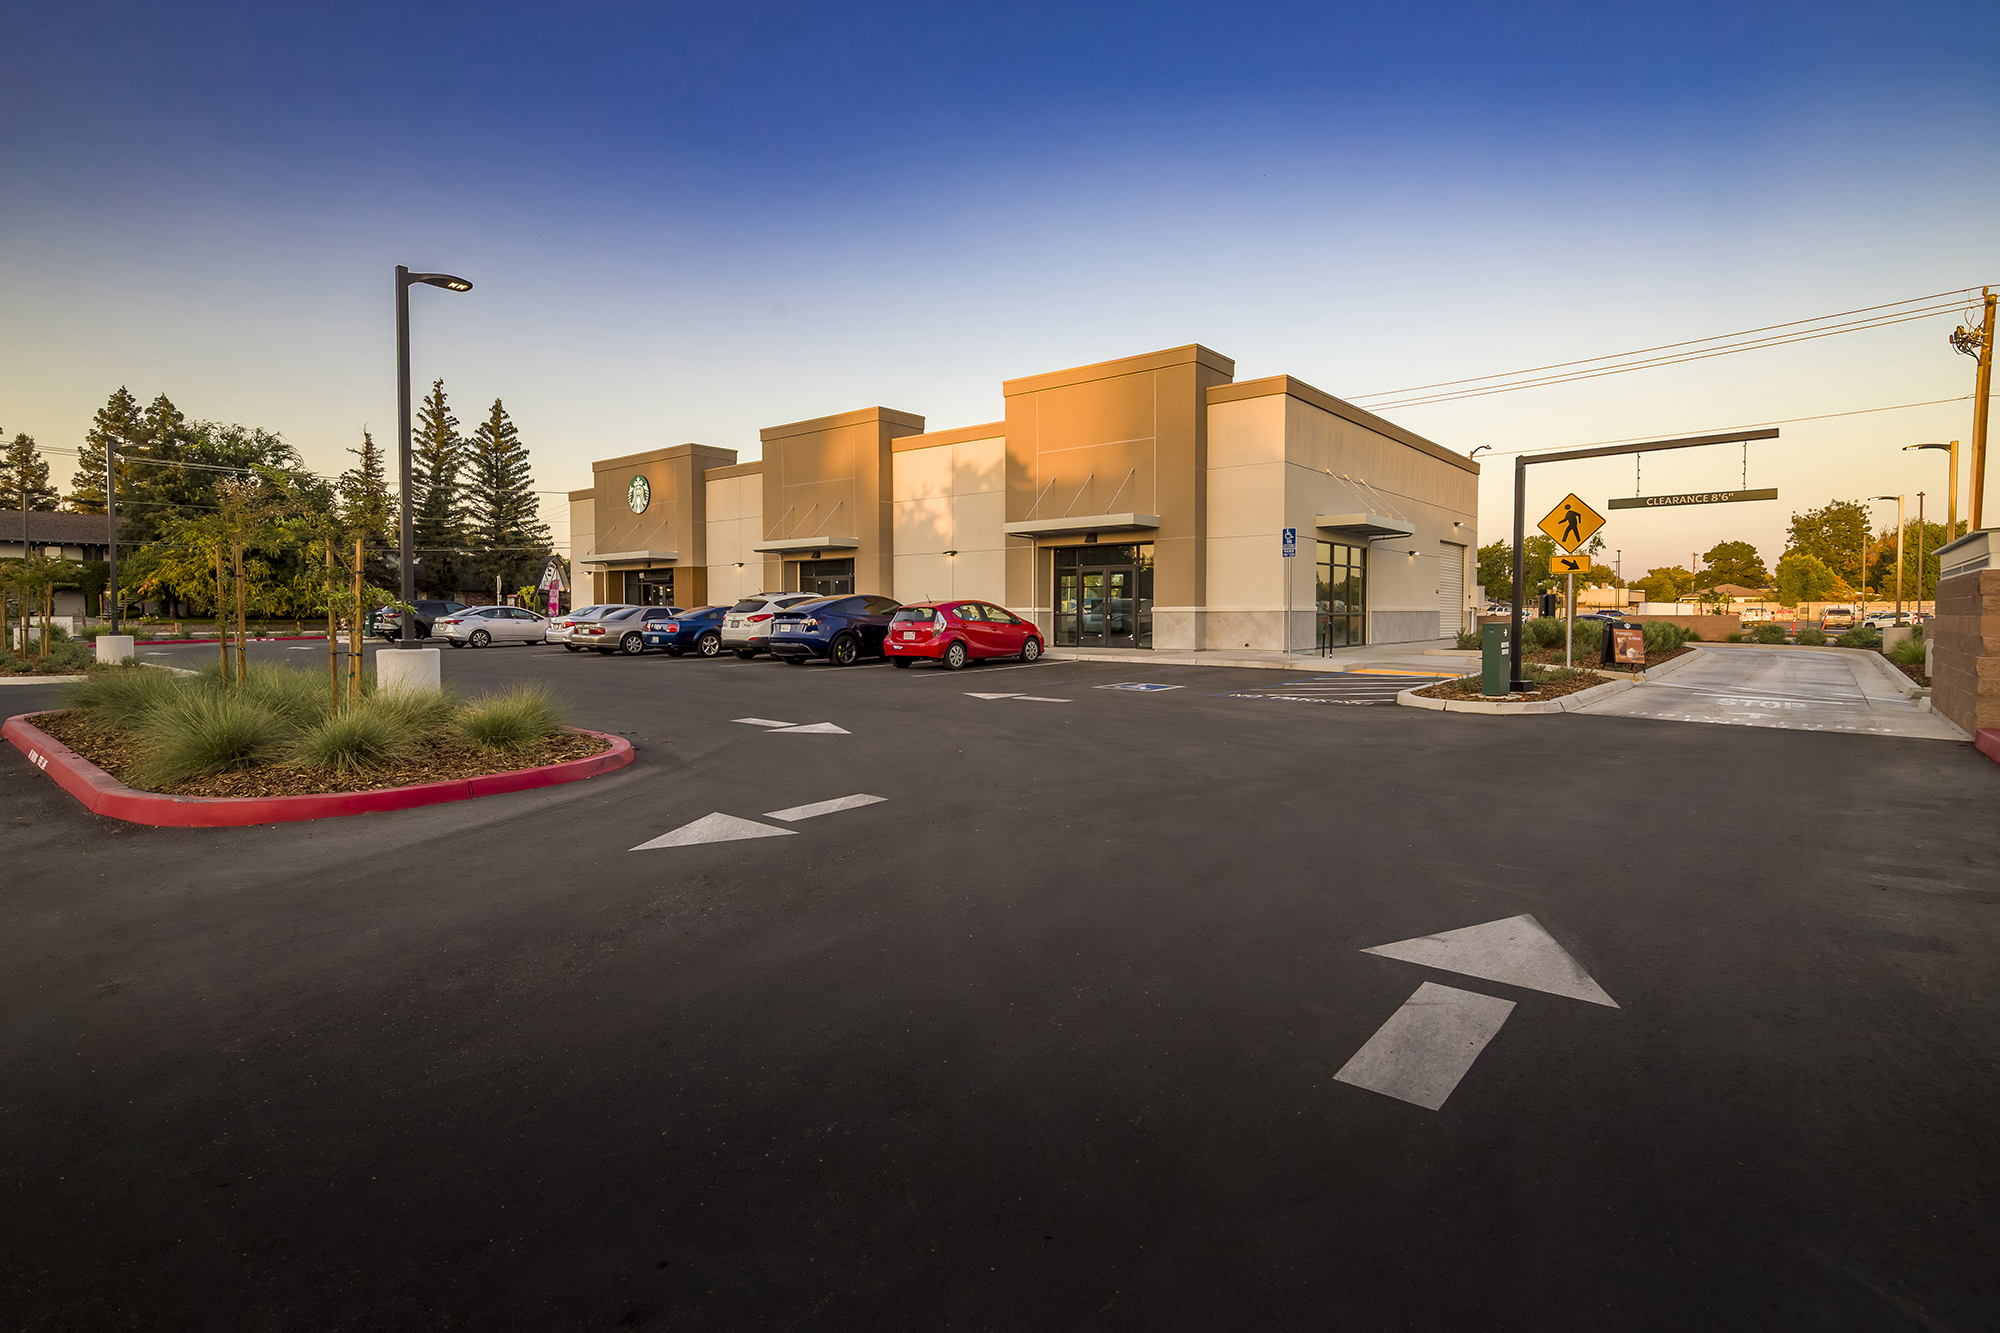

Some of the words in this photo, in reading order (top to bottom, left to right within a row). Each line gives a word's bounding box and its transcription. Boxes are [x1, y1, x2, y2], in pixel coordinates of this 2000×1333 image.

[1646, 494, 1708, 506] CLEARANCE
[1711, 493, 1734, 502] 8'6"
[1716, 698, 1807, 710] STOP
